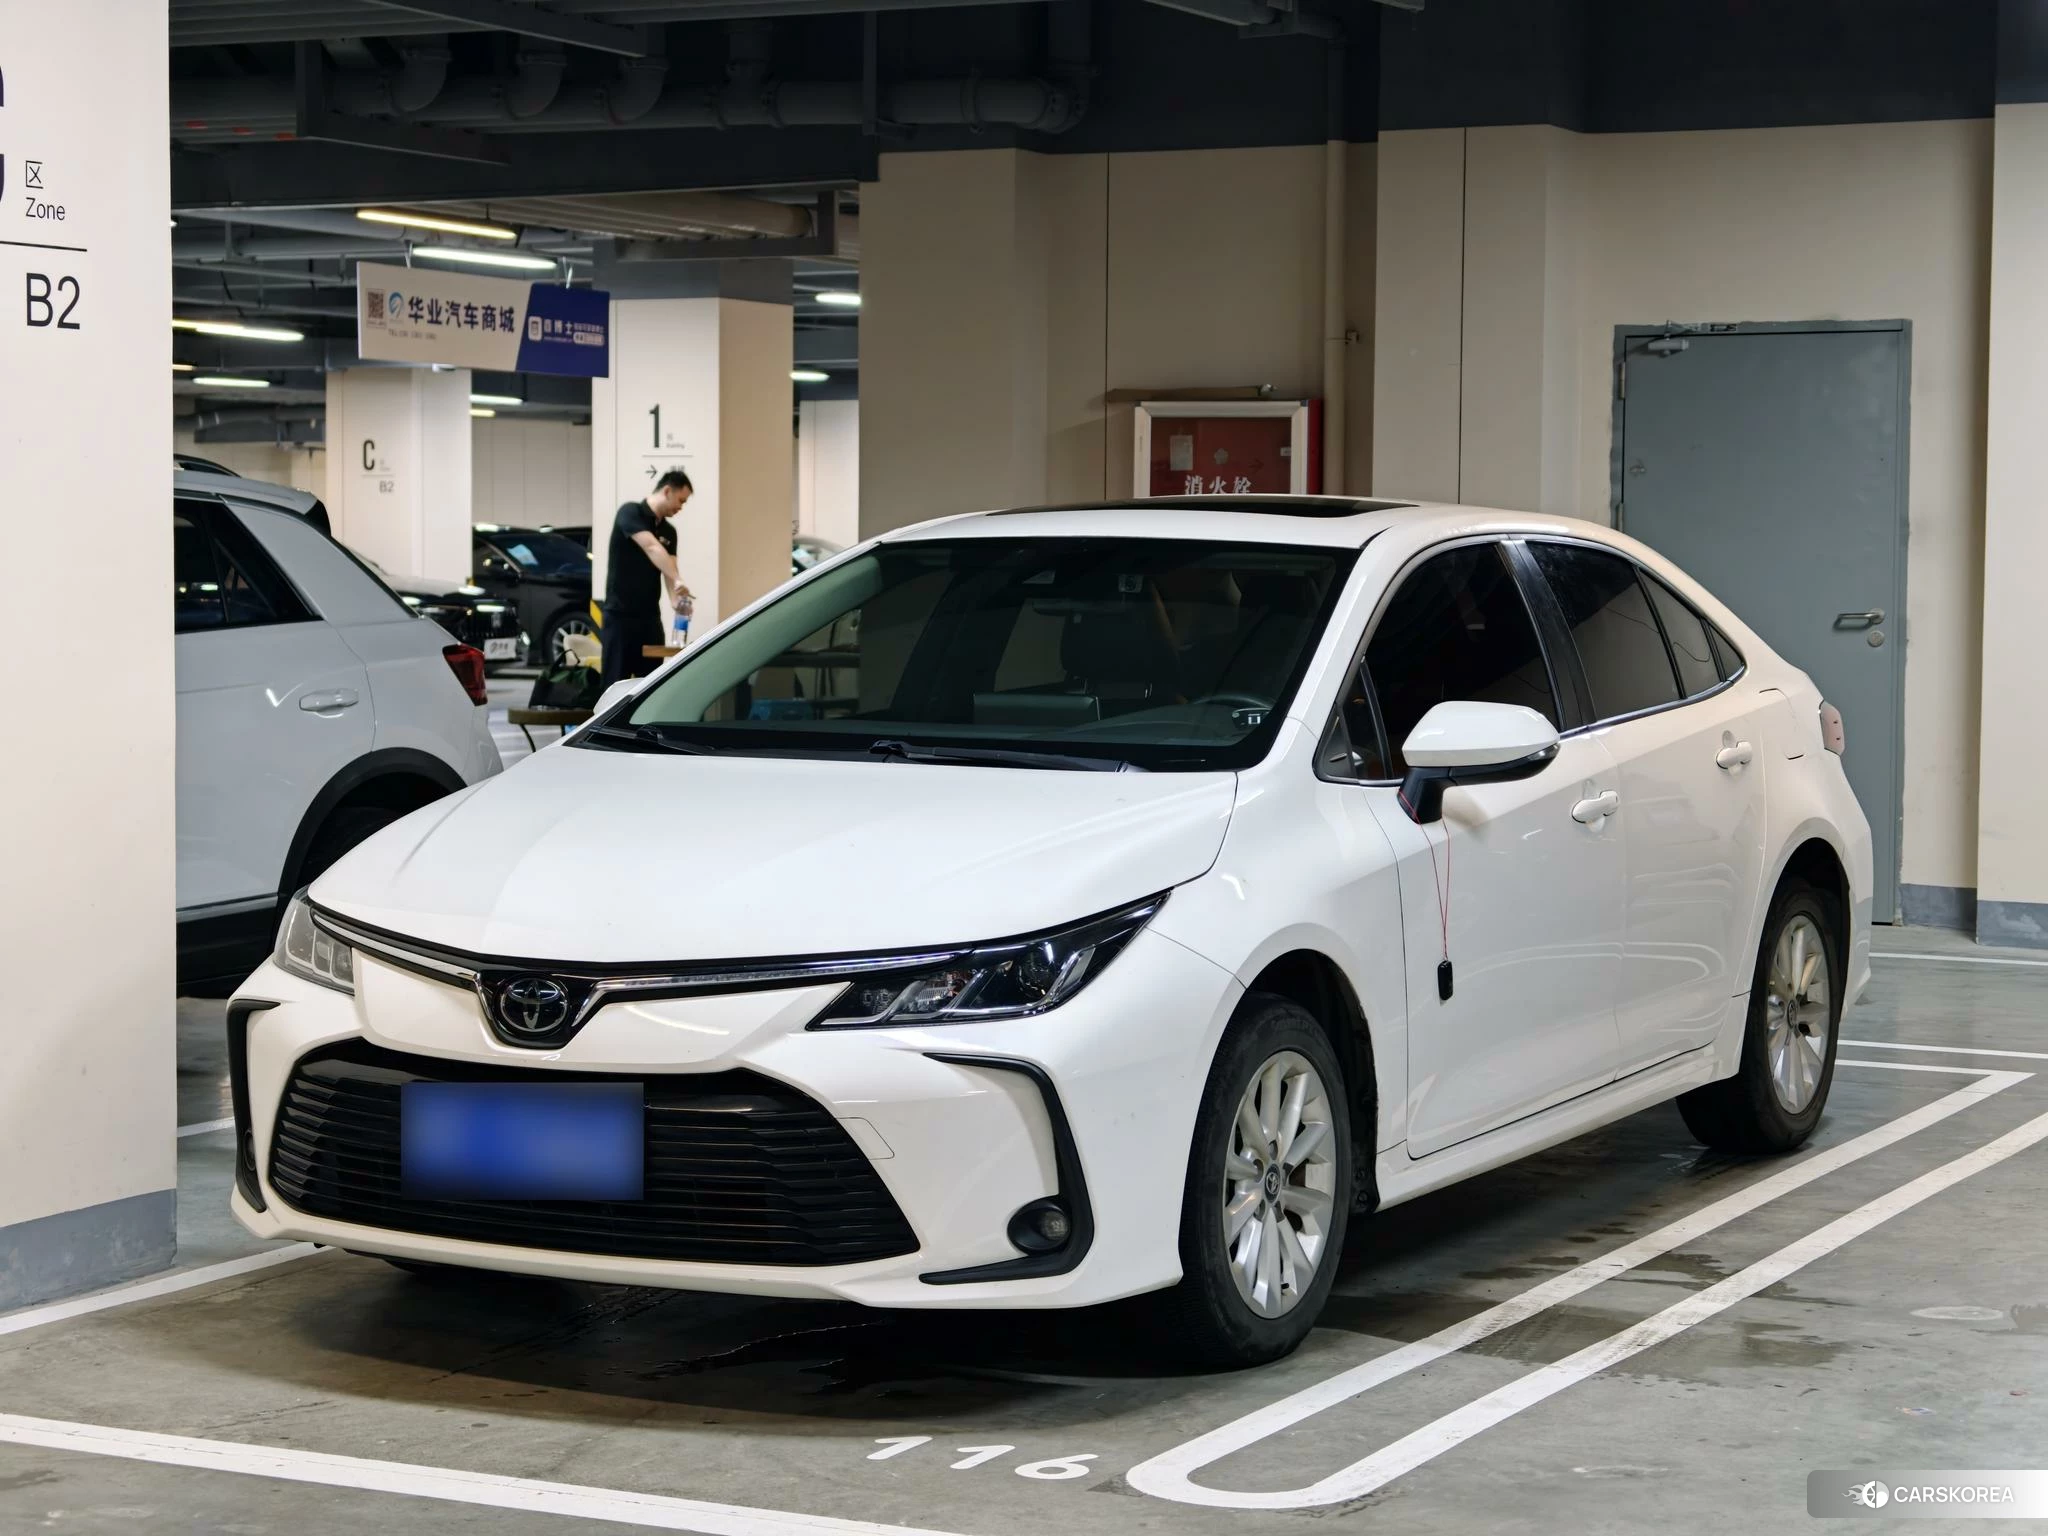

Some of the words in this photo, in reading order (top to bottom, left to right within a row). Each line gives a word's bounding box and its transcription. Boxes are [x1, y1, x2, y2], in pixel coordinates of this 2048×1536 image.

[25, 160, 43, 189] 区
[25, 197, 66, 221] Zone
[26, 272, 81, 330] B2
[408, 295, 515, 334] 华业汽车商城
[648, 402, 660, 449] 1
[363, 439, 375, 471] C
[379, 480, 395, 494] B2
[866, 1435, 1100, 1480] 116
